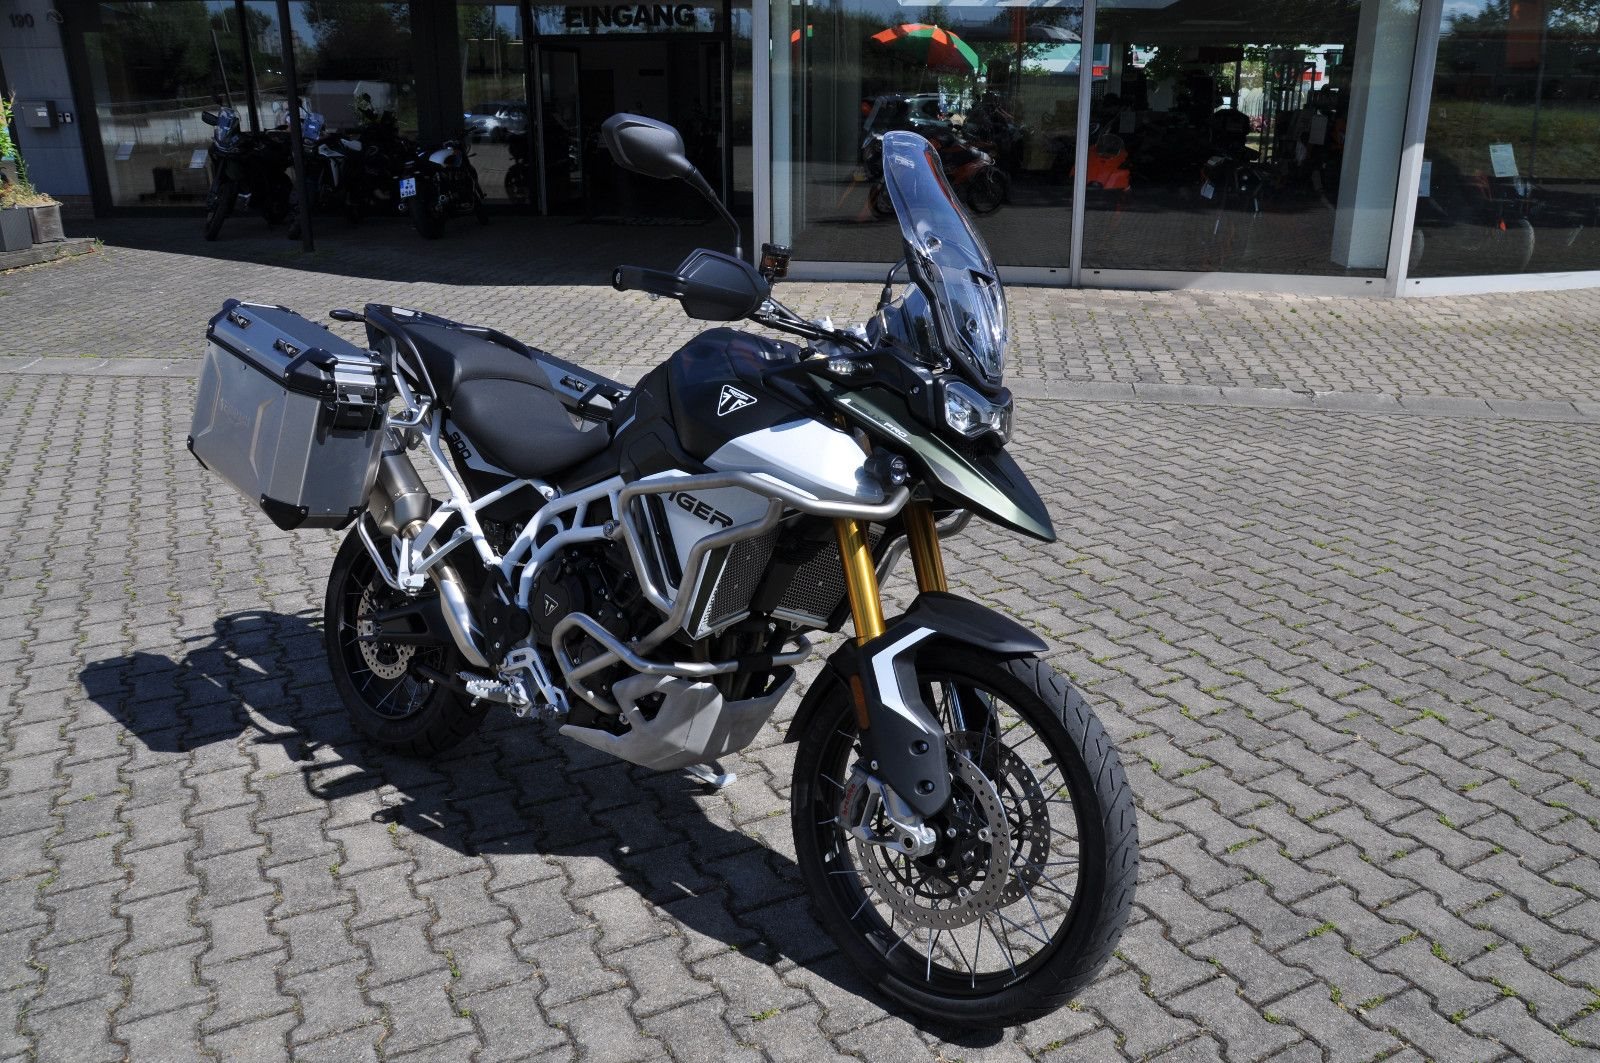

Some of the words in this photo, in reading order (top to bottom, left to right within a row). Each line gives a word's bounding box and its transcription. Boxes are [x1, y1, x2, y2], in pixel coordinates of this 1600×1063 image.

[9, 13, 34, 28] 190
[565, 4, 695, 27] EINGANG
[883, 422, 908, 438] PRO
[450, 431, 472, 460] 900
[668, 491, 734, 528] IGER
